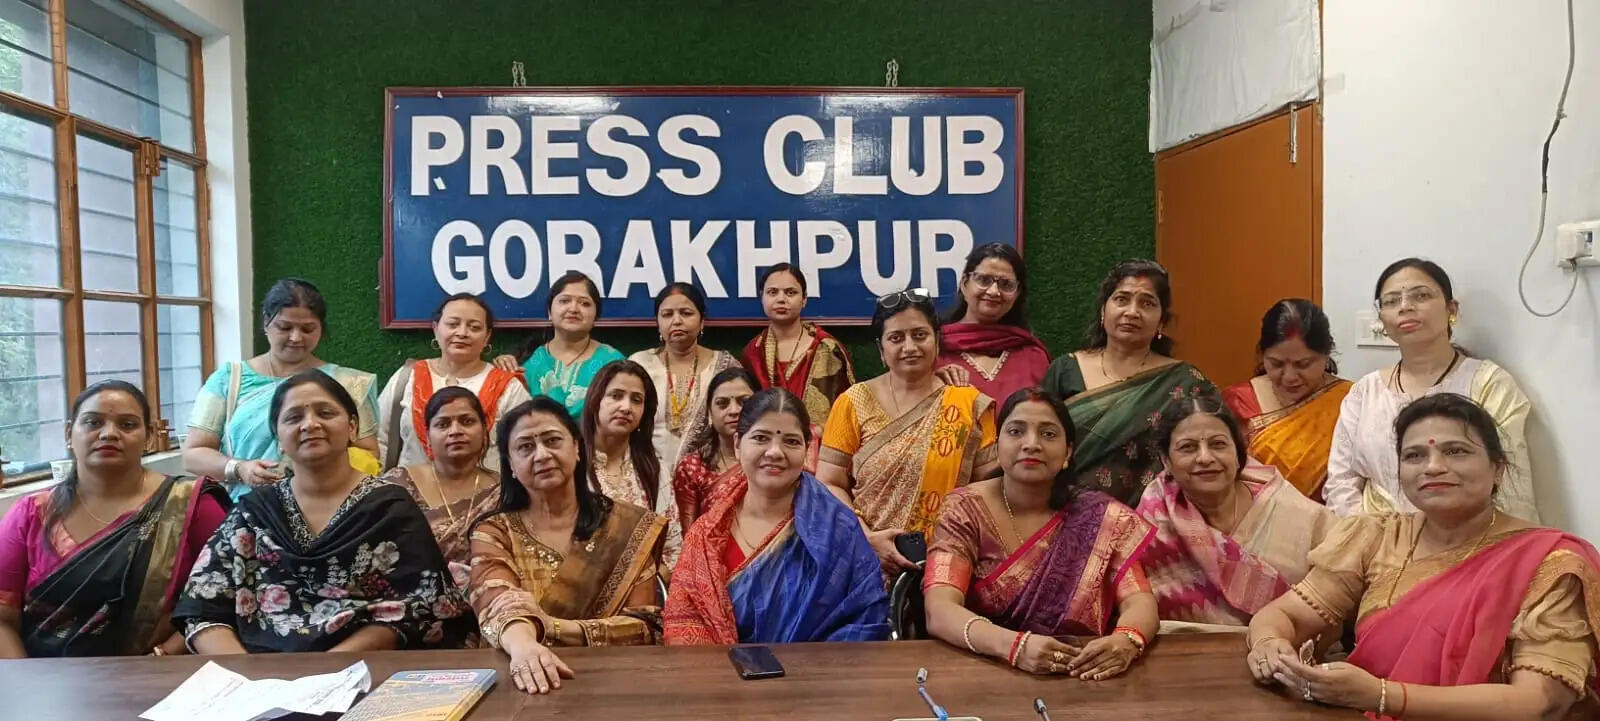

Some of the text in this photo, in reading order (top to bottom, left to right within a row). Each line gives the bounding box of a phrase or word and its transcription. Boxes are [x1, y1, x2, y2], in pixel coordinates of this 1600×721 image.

[410, 114, 1005, 197] PRESS CLUB
[431, 219, 974, 299] GORAKHPUR
